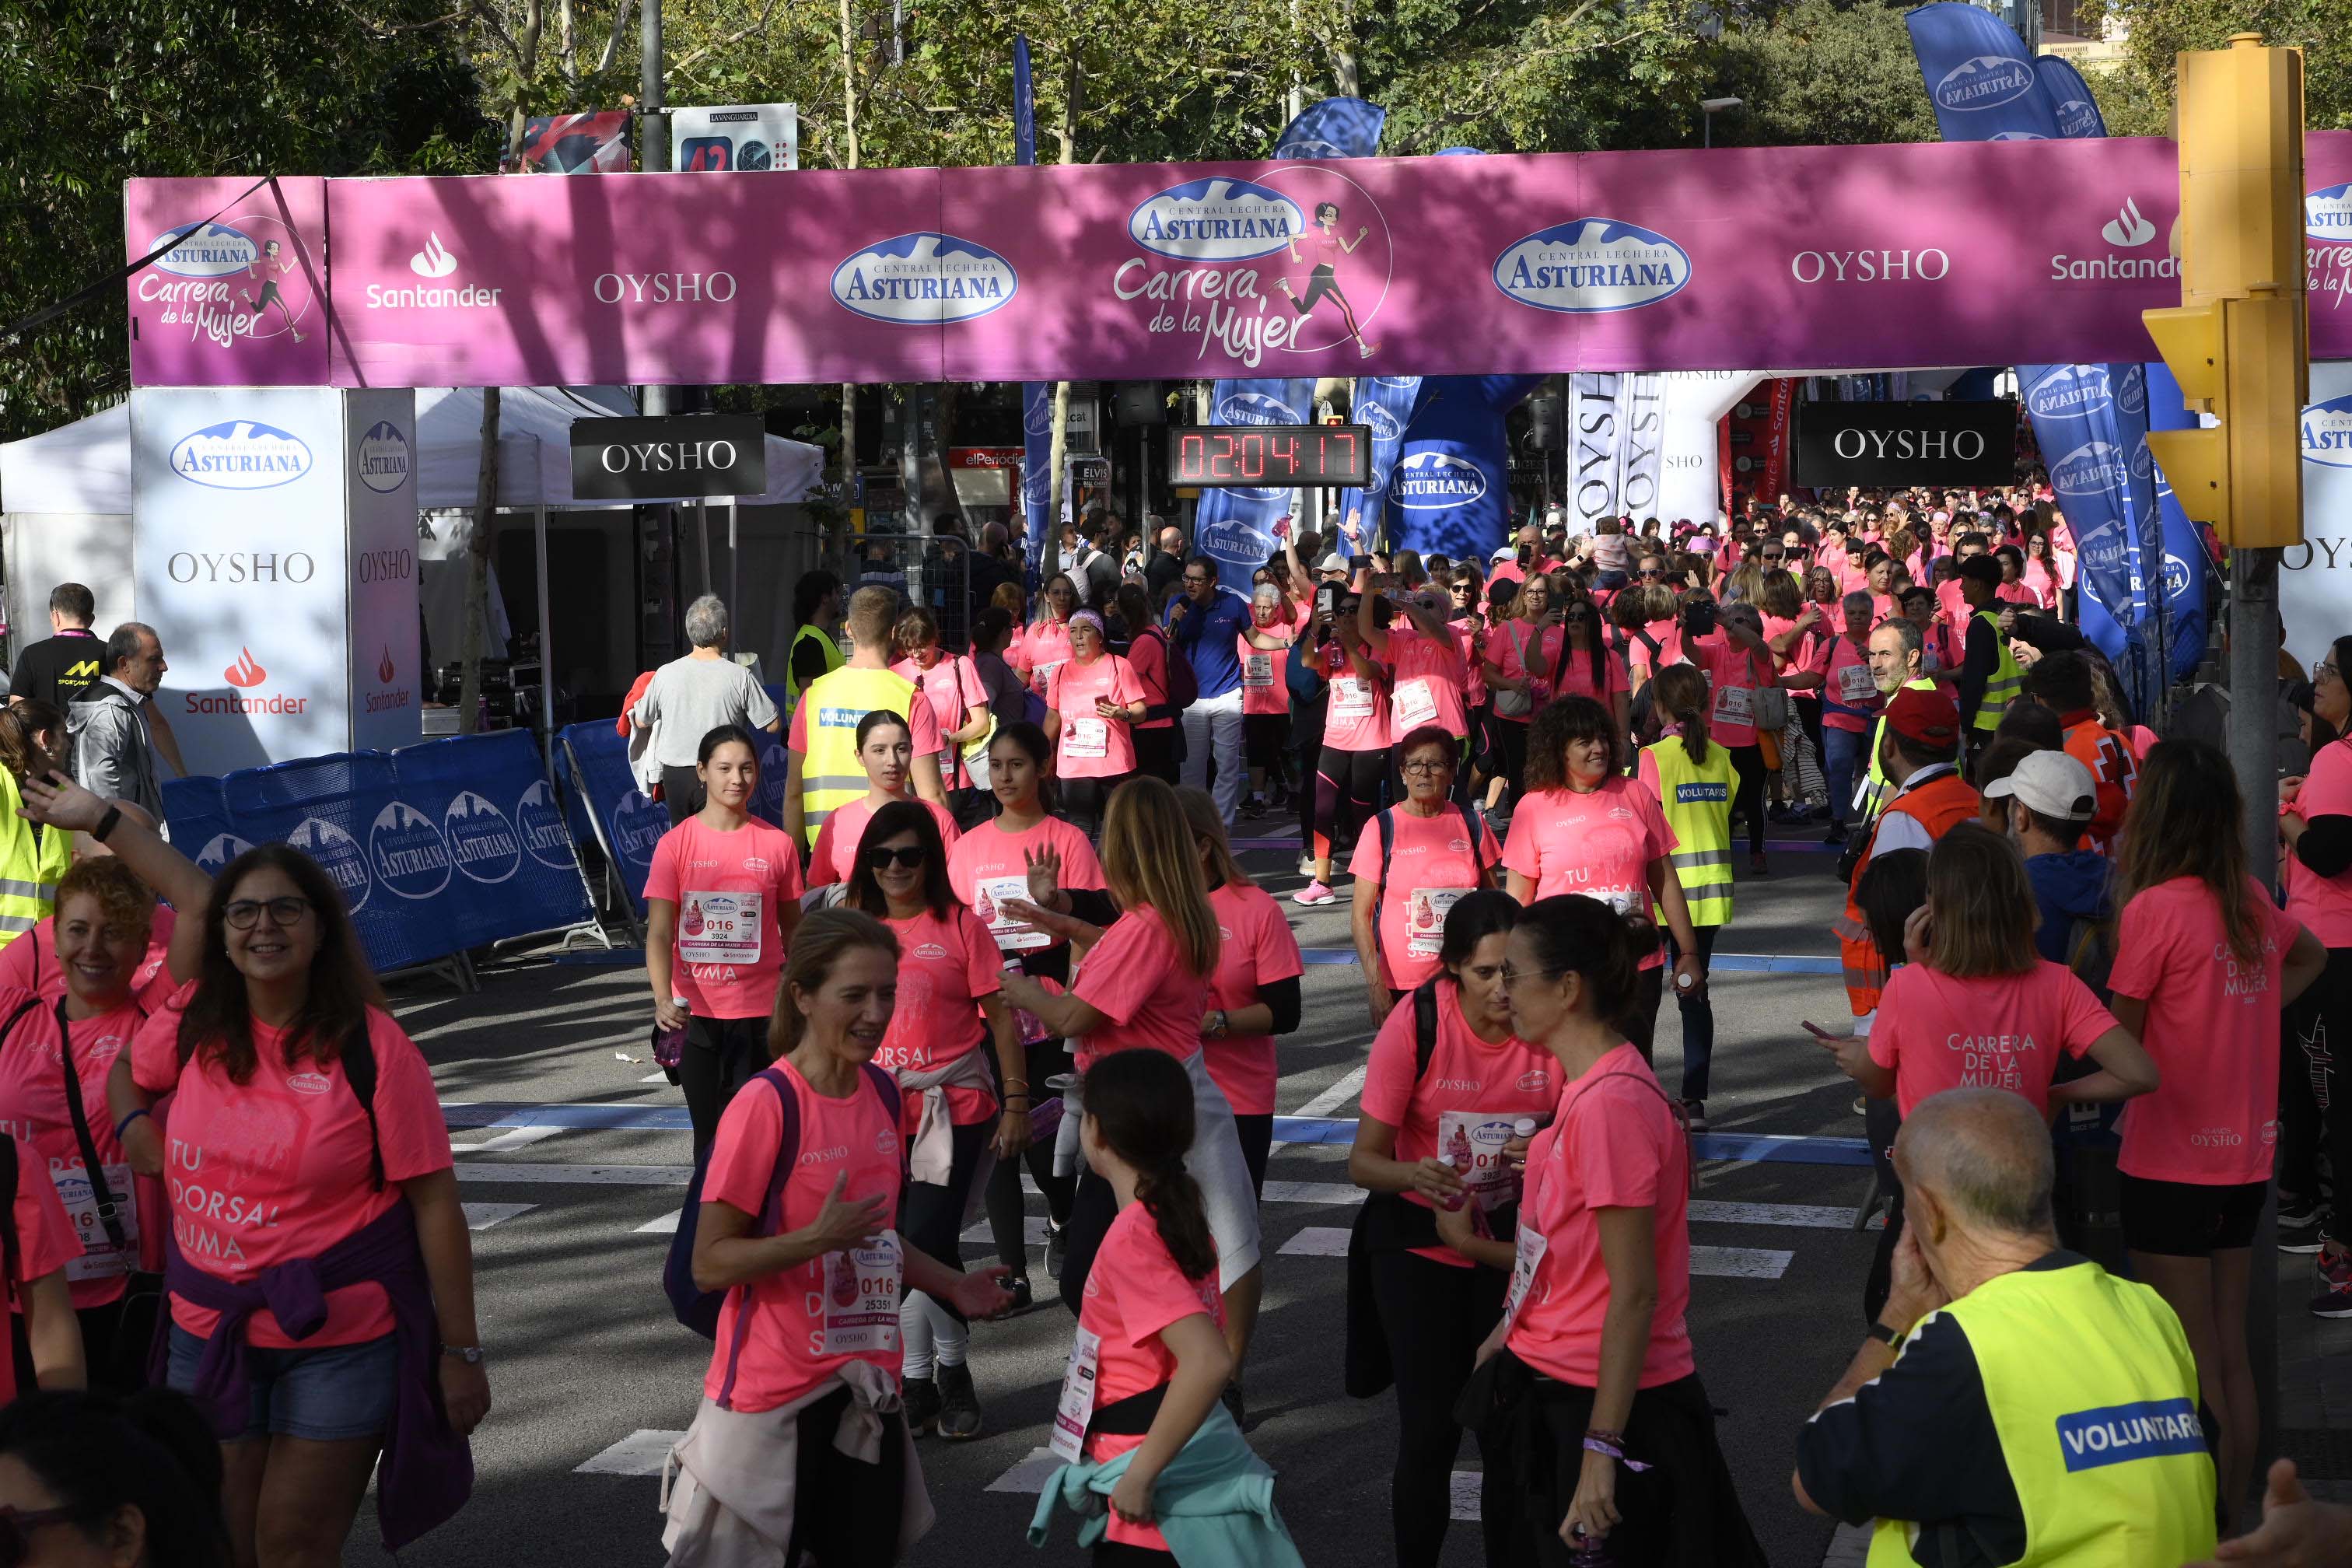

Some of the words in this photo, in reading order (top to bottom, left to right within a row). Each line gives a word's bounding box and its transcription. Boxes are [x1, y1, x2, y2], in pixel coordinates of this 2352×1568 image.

[1168, 205, 1225, 215] CENTRAL
[1230, 205, 1286, 215] LECHERA
[1142, 210, 1291, 241] ASTURIANA
[873, 264, 933, 273] CENTRAL
[939, 262, 997, 272] LECHERA
[1538, 251, 1600, 261] CENTRAL
[1606, 250, 1669, 260] LECHERA
[1792, 248, 1950, 284] OYSHO
[845, 267, 1003, 300] ASTURIANA
[1114, 257, 1258, 301] Carrera
[1508, 254, 1676, 289] ASTURIANA
[2323, 269, 2338, 291] la
[138, 273, 229, 303] Carrera
[367, 284, 502, 308] Santander
[594, 271, 737, 303] OYSHO
[161, 304, 177, 324] de
[181, 303, 194, 324] la
[191, 299, 264, 348] Mujer
[1150, 303, 1175, 333] de
[1181, 302, 1201, 333] la
[1198, 295, 1313, 369] Mujer
[1181, 435, 1355, 478] 02:04:17
[1834, 429, 1985, 460] OYSHO
[181, 446, 302, 473] ASTURIANA
[362, 447, 408, 475] ASTURIANA
[601, 440, 737, 474] OYSHO
[1083, 467, 1108, 478] ELVIS
[1401, 471, 1434, 479] CENTRAL
[1391, 474, 1479, 497] ASTURIANA
[1204, 534, 1269, 559] ASTURIANA
[168, 551, 315, 583] OYSHO
[359, 548, 411, 584] OYSHO
[186, 693, 307, 715] Santander
[366, 688, 410, 714] Santander
[452, 828, 518, 863] ASTURIANA
[378, 842, 450, 879] ASTURIANA
[1564, 866, 1589, 884] TU
[706, 920, 733, 930] 016
[915, 948, 944, 957] ASTURIANA
[2224, 976, 2268, 996] MUJER
[1947, 1033, 2036, 1053] CARRERA
[1965, 1053, 1991, 1071] DE
[1997, 1055, 2019, 1072] LA
[290, 1079, 328, 1090] ASTURIANA
[1437, 1078, 1480, 1091] OYSHO
[1960, 1071, 2023, 1090] MUJER
[2191, 1134, 2242, 1147] OYSHO
[172, 1138, 202, 1171] TU
[802, 1145, 849, 1166] OYSHO
[173, 1178, 280, 1228] DORSAL
[177, 1215, 246, 1261] SUMA
[861, 1277, 894, 1295] 016
[865, 1300, 891, 1311] 25351
[835, 1332, 868, 1345] OYSHO
